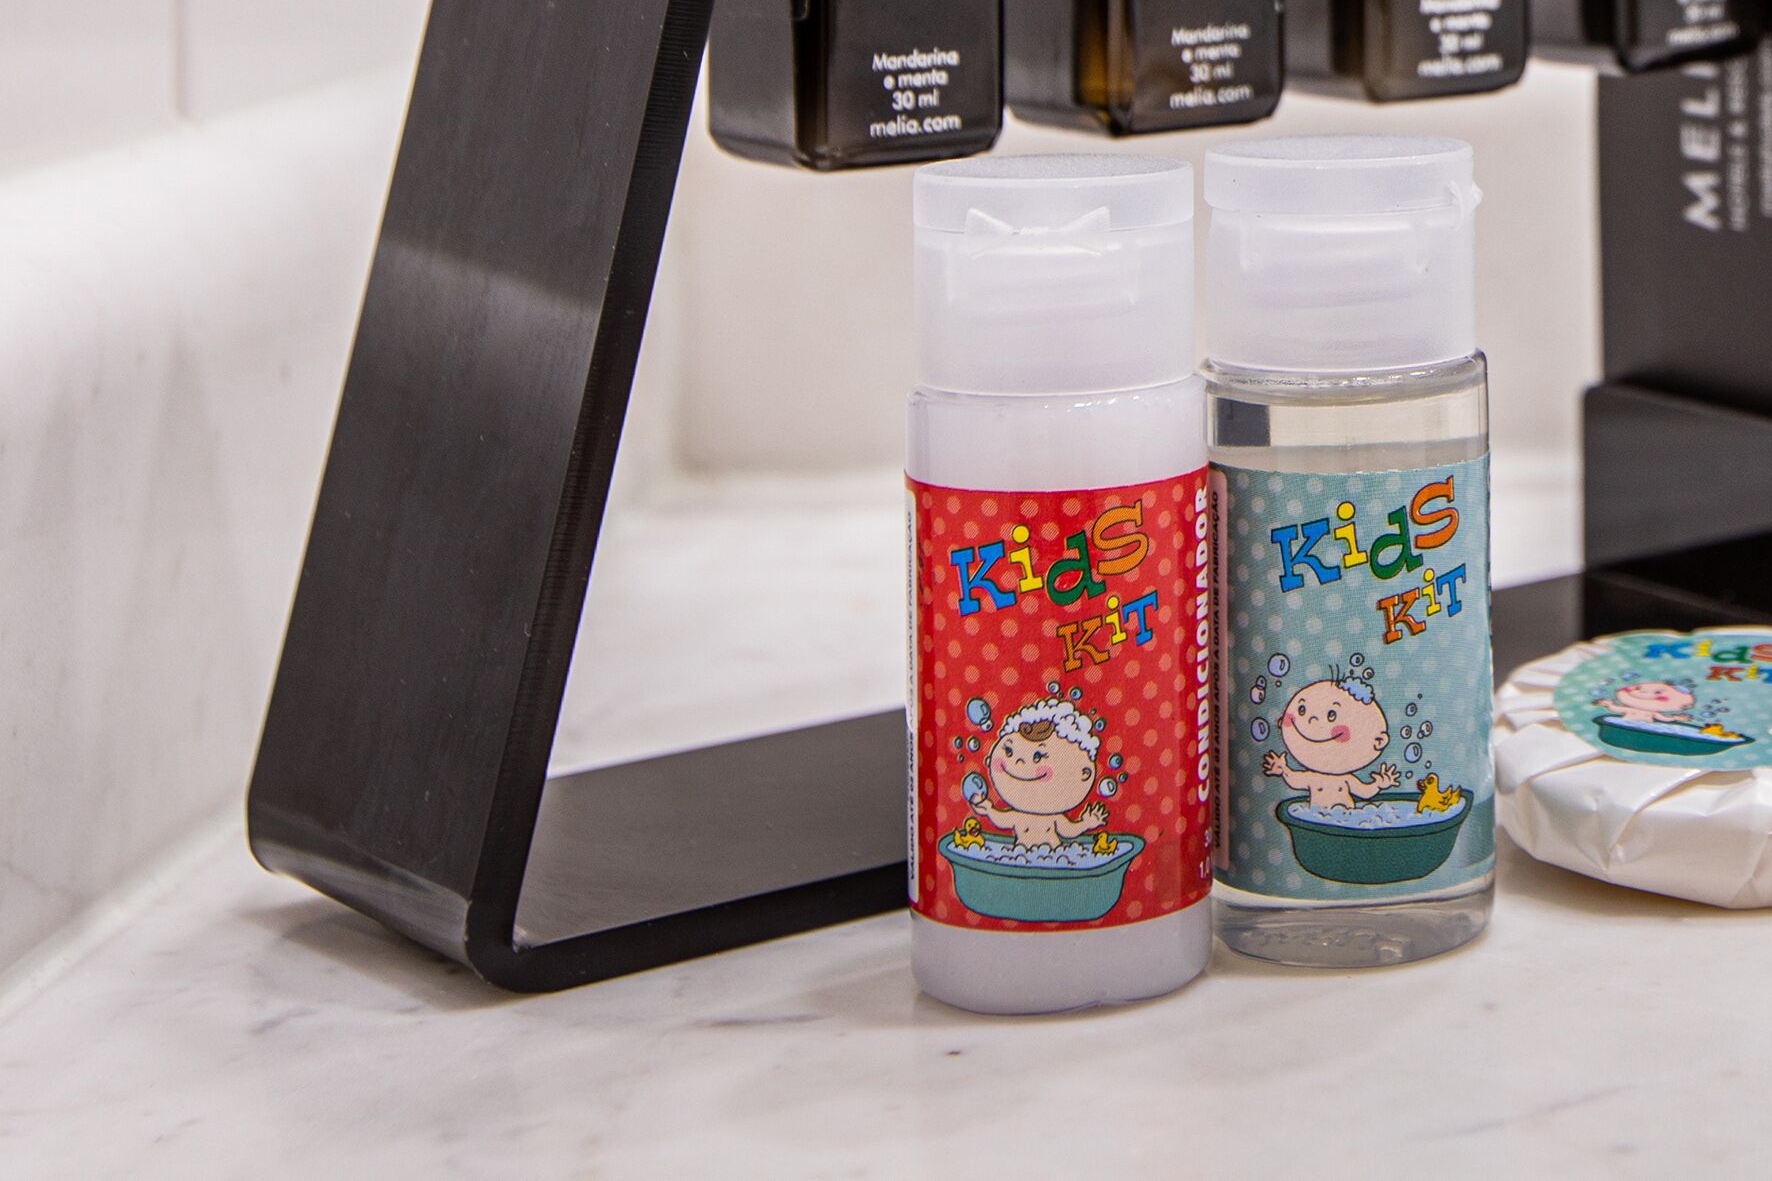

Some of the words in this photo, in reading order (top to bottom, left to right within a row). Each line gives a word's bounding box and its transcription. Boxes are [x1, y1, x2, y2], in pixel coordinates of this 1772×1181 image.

[871, 46, 960, 72] Mandarina
[882, 74, 896, 90] e
[897, 68, 949, 89] menta
[1189, 61, 1212, 83] 30
[891, 89, 916, 111] 30
[917, 87, 940, 108] ml
[869, 114, 962, 138] melia.com
[1681, 61, 1722, 231] MELI
[1211, 490, 1220, 584] FABRICAÇÃO
[1195, 483, 1211, 802] CONDICIONADOR
